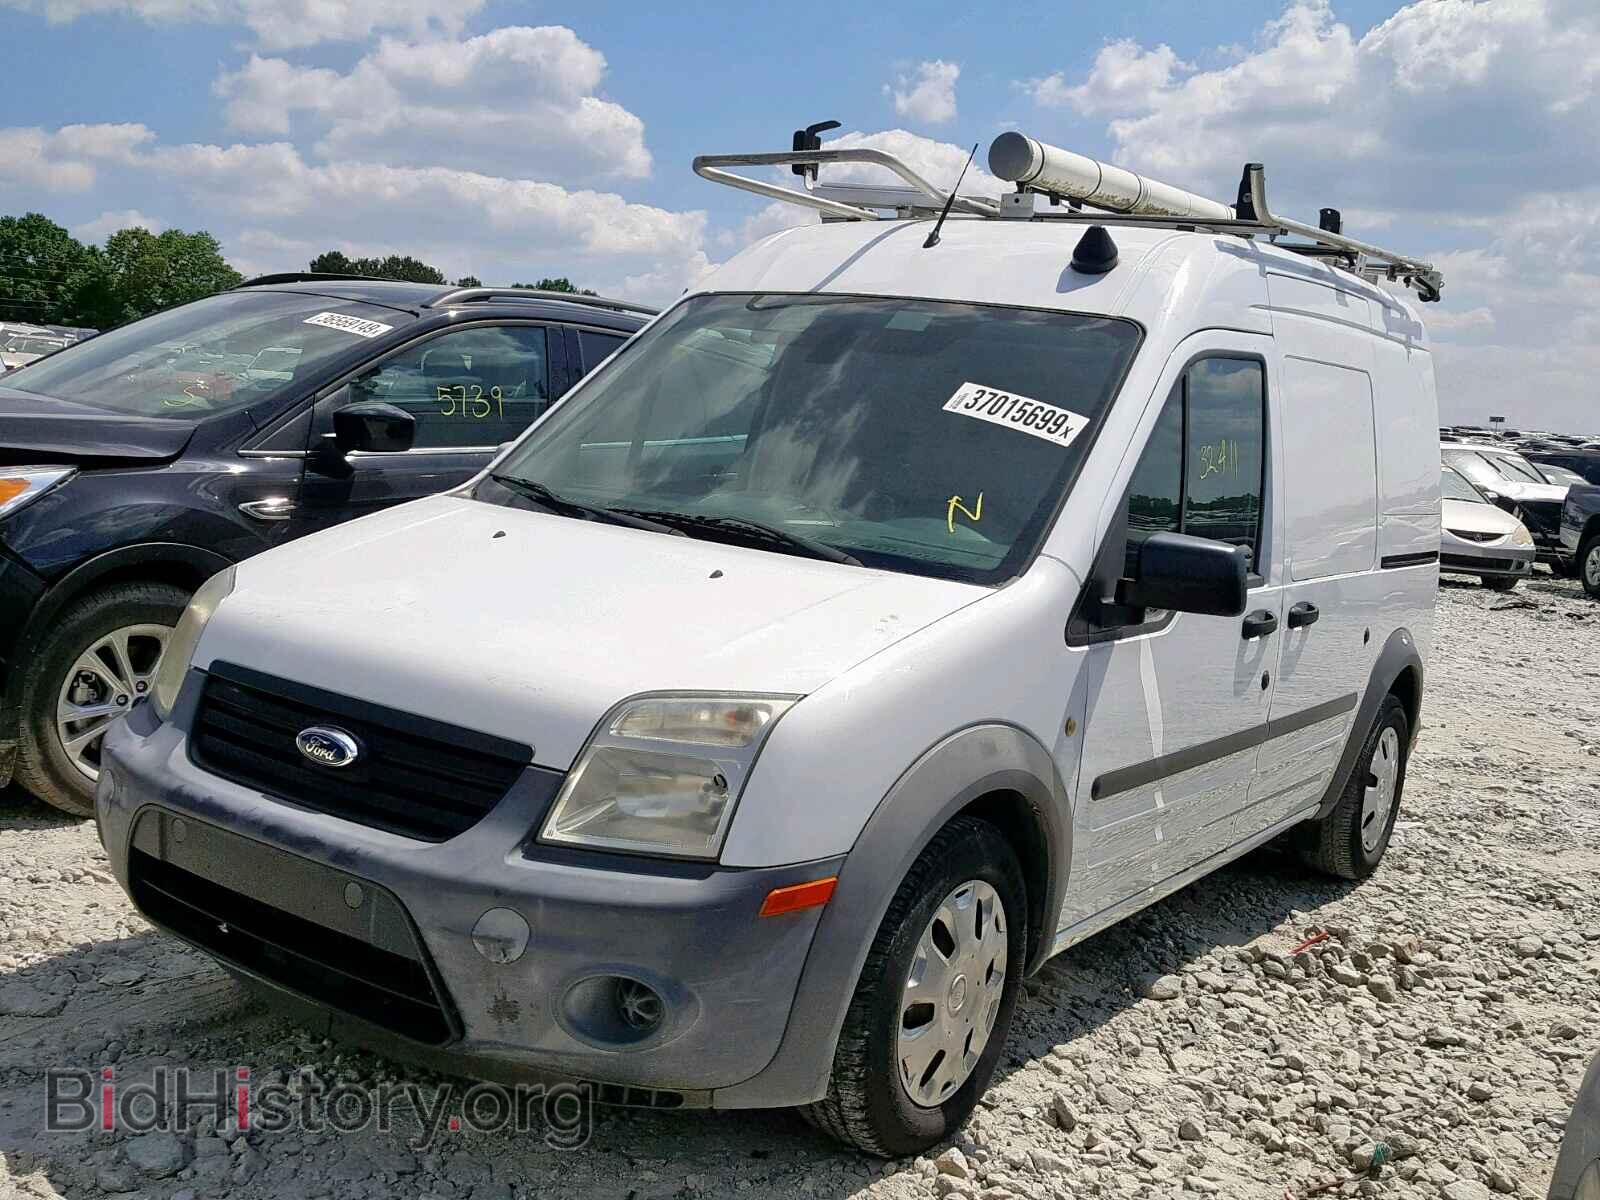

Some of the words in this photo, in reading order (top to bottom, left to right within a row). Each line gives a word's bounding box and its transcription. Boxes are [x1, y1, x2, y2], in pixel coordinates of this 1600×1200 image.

[436, 384, 503, 421] 5739
[946, 491, 984, 533] N
[305, 736, 337, 761] Ford
